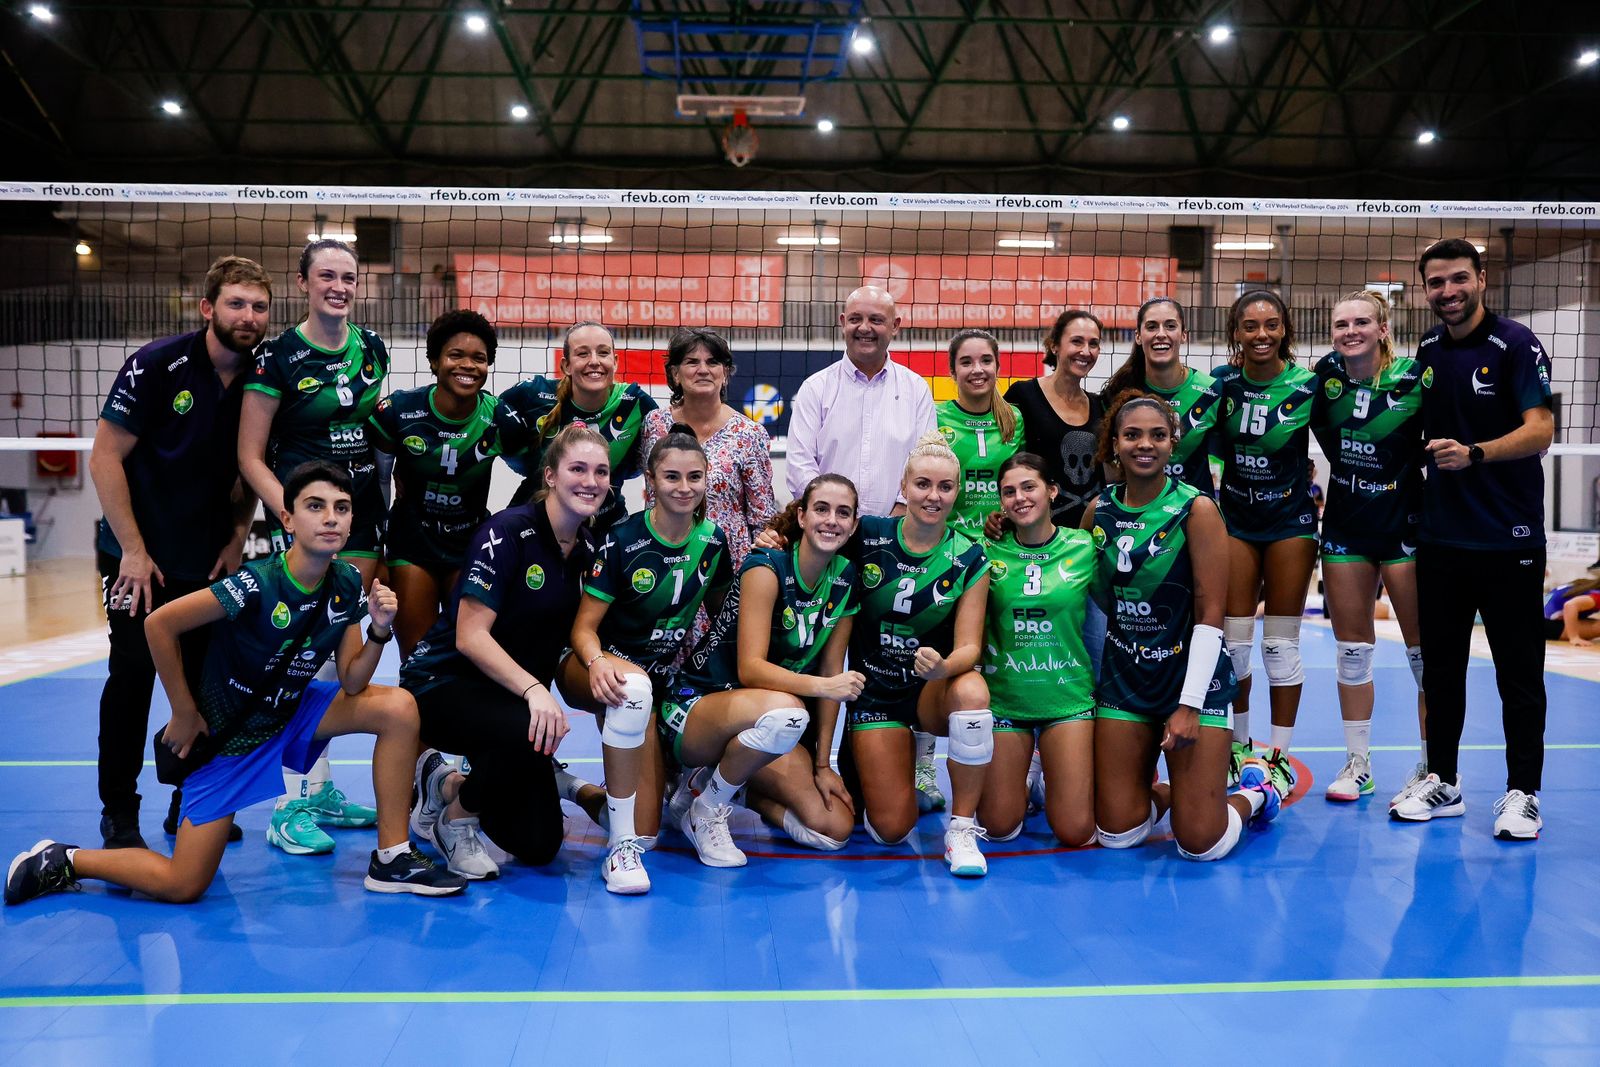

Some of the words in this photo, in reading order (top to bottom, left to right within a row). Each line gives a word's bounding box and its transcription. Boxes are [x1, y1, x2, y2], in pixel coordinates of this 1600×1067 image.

[42, 184, 114, 196] rfevb.com
[237, 187, 308, 199] rfevb.com
[430, 190, 500, 201] rfevb.com
[621, 192, 690, 203] rfevb.com
[810, 194, 878, 205] rfevb.com
[996, 196, 1063, 208] rfevb.com
[1178, 199, 1244, 210] rfevb.com
[1356, 202, 1421, 213] rfevb.com
[1532, 204, 1596, 215] rfevb.com
[637, 277, 699, 292] Deportes
[478, 302, 607, 322] Ayuntamiento
[611, 302, 634, 319] de
[640, 303, 674, 320] Dos
[680, 303, 769, 321] Hermanas
[1018, 302, 1033, 320] de
[336, 374, 353, 406] 6
[1352, 388, 1371, 419] 9
[1240, 402, 1268, 435] 15
[330, 428, 364, 442] PRO
[975, 428, 987, 457] 1
[1341, 438, 1376, 454] PRO
[440, 444, 458, 475] 4
[1235, 454, 1268, 468] PRO
[965, 469, 994, 480] FP
[966, 481, 998, 493] PRO
[1358, 480, 1397, 494] Cajasol
[424, 490, 462, 506] PRO
[1256, 488, 1292, 502] Cajasol
[1116, 535, 1135, 572] 8
[468, 573, 492, 591] Cajasol
[1023, 564, 1042, 596] 3
[671, 569, 684, 606] 1
[1113, 586, 1142, 600] FP
[893, 578, 916, 614] 2
[1012, 608, 1047, 619] FP
[1117, 601, 1152, 617] PRO
[1014, 620, 1053, 634] PRO
[650, 628, 686, 641] PRO
[880, 634, 919, 649] PRO
[1142, 641, 1183, 662] Cajasol
[1004, 651, 1082, 673] Andalucía
